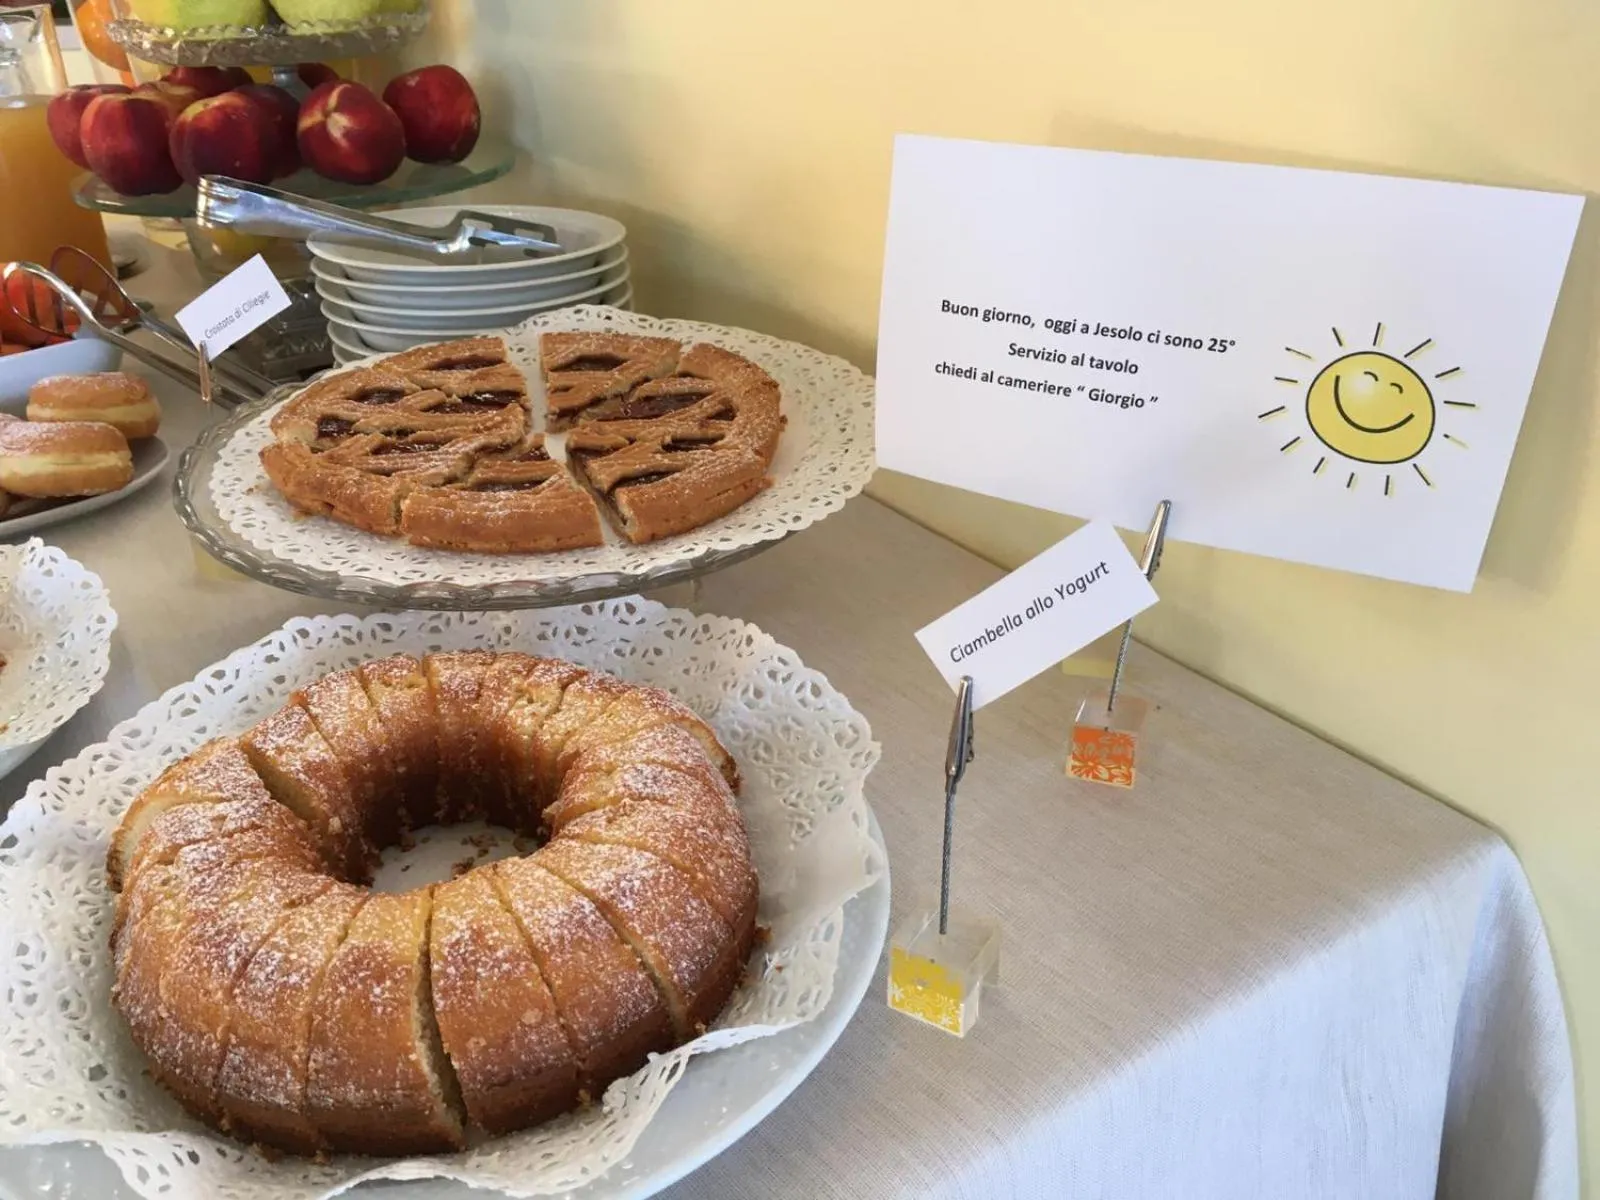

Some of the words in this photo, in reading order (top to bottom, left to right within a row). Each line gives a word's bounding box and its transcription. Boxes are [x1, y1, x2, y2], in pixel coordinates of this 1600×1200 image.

[204, 314, 236, 339] Crostata
[234, 306, 243, 319] di
[941, 299, 979, 318] Buon
[981, 307, 1036, 329] giorno,
[1043, 318, 1077, 335] oggi
[1080, 323, 1090, 335] a
[1092, 322, 1143, 342] Jesolo
[1146, 329, 1161, 344] ci
[1163, 334, 1204, 350] sono
[1008, 342, 1067, 364] Servizio
[1070, 352, 1086, 367] al
[1089, 356, 1139, 375] tavolo
[934, 361, 978, 381] chiedi
[980, 370, 994, 384] al
[997, 375, 1072, 398] cameriere
[1088, 388, 1145, 409] Giorgio
[950, 614, 1023, 663] Ciambella
[1025, 596, 1054, 620] allo
[1054, 561, 1110, 600] Yogurt
